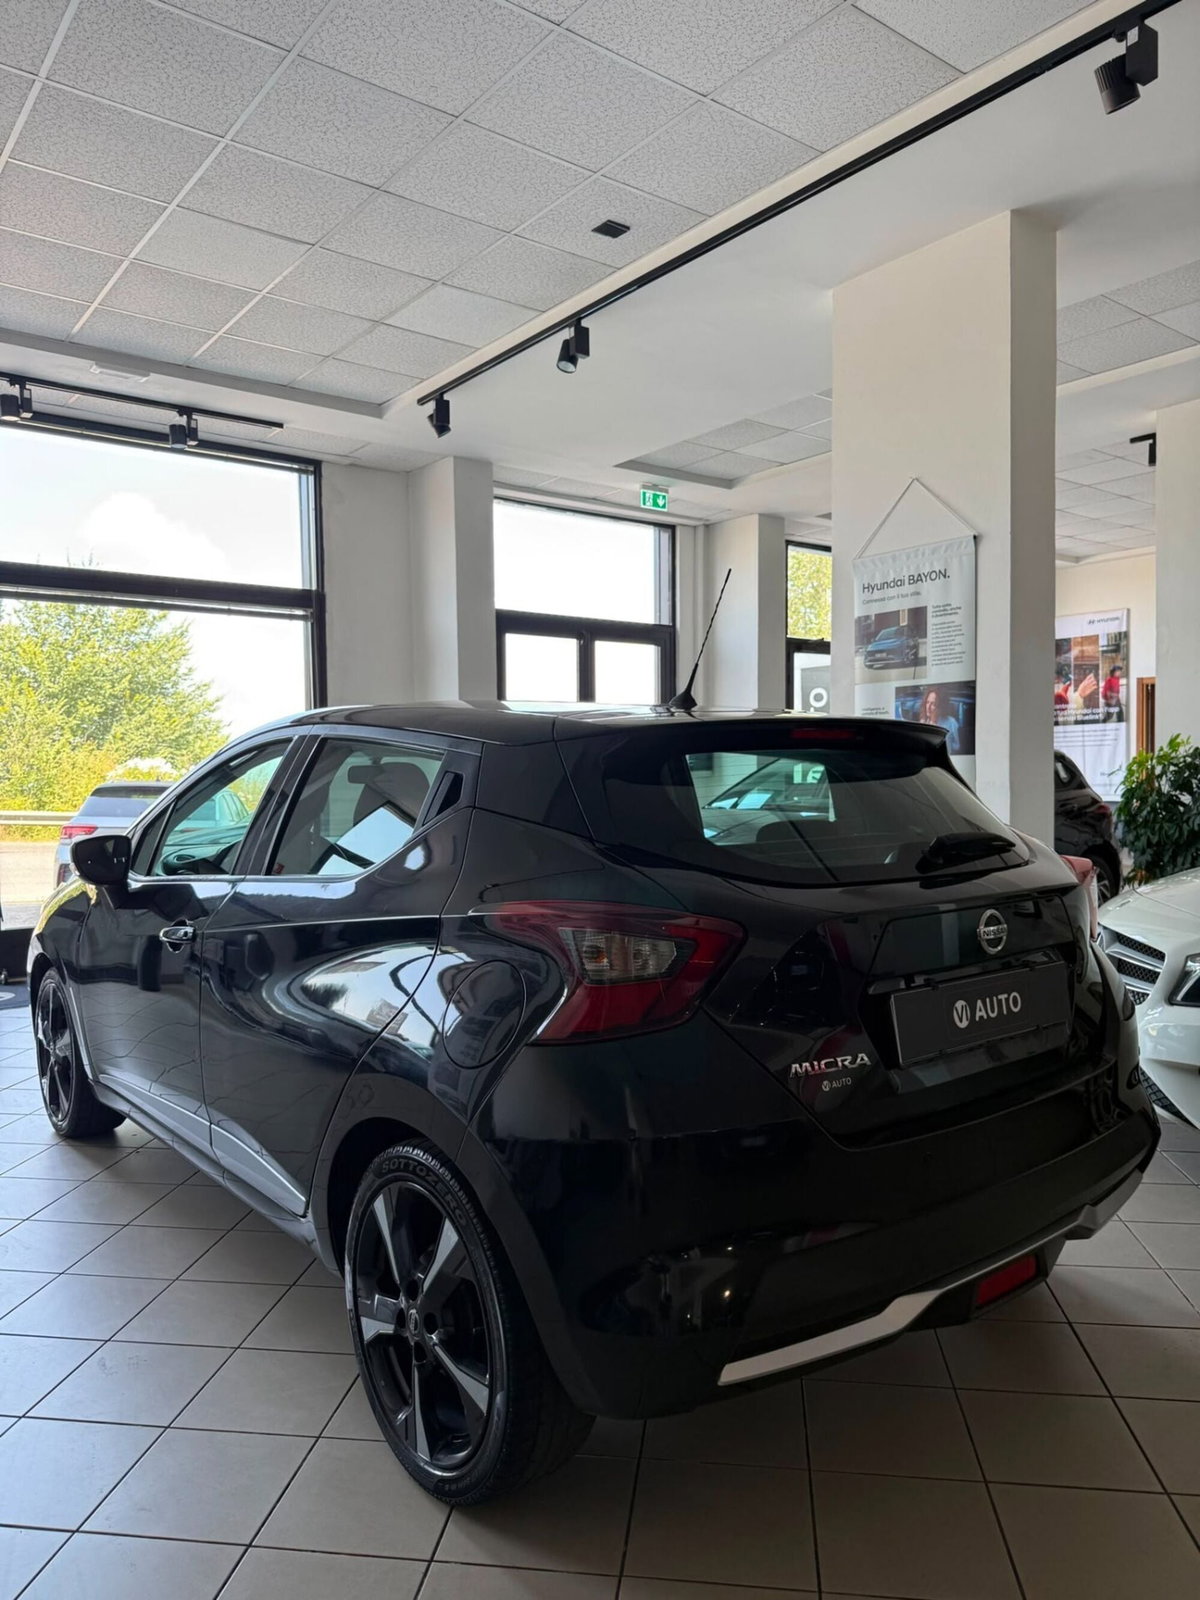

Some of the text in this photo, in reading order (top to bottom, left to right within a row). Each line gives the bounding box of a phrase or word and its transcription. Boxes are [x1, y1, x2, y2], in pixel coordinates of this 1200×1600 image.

[862, 568, 950, 594] Hyundai BAYON.
[982, 926, 1007, 937] NISSAN
[975, 991, 1022, 1022] AUTO
[789, 1052, 872, 1078] MICRA
[832, 1077, 852, 1089] AUTO
